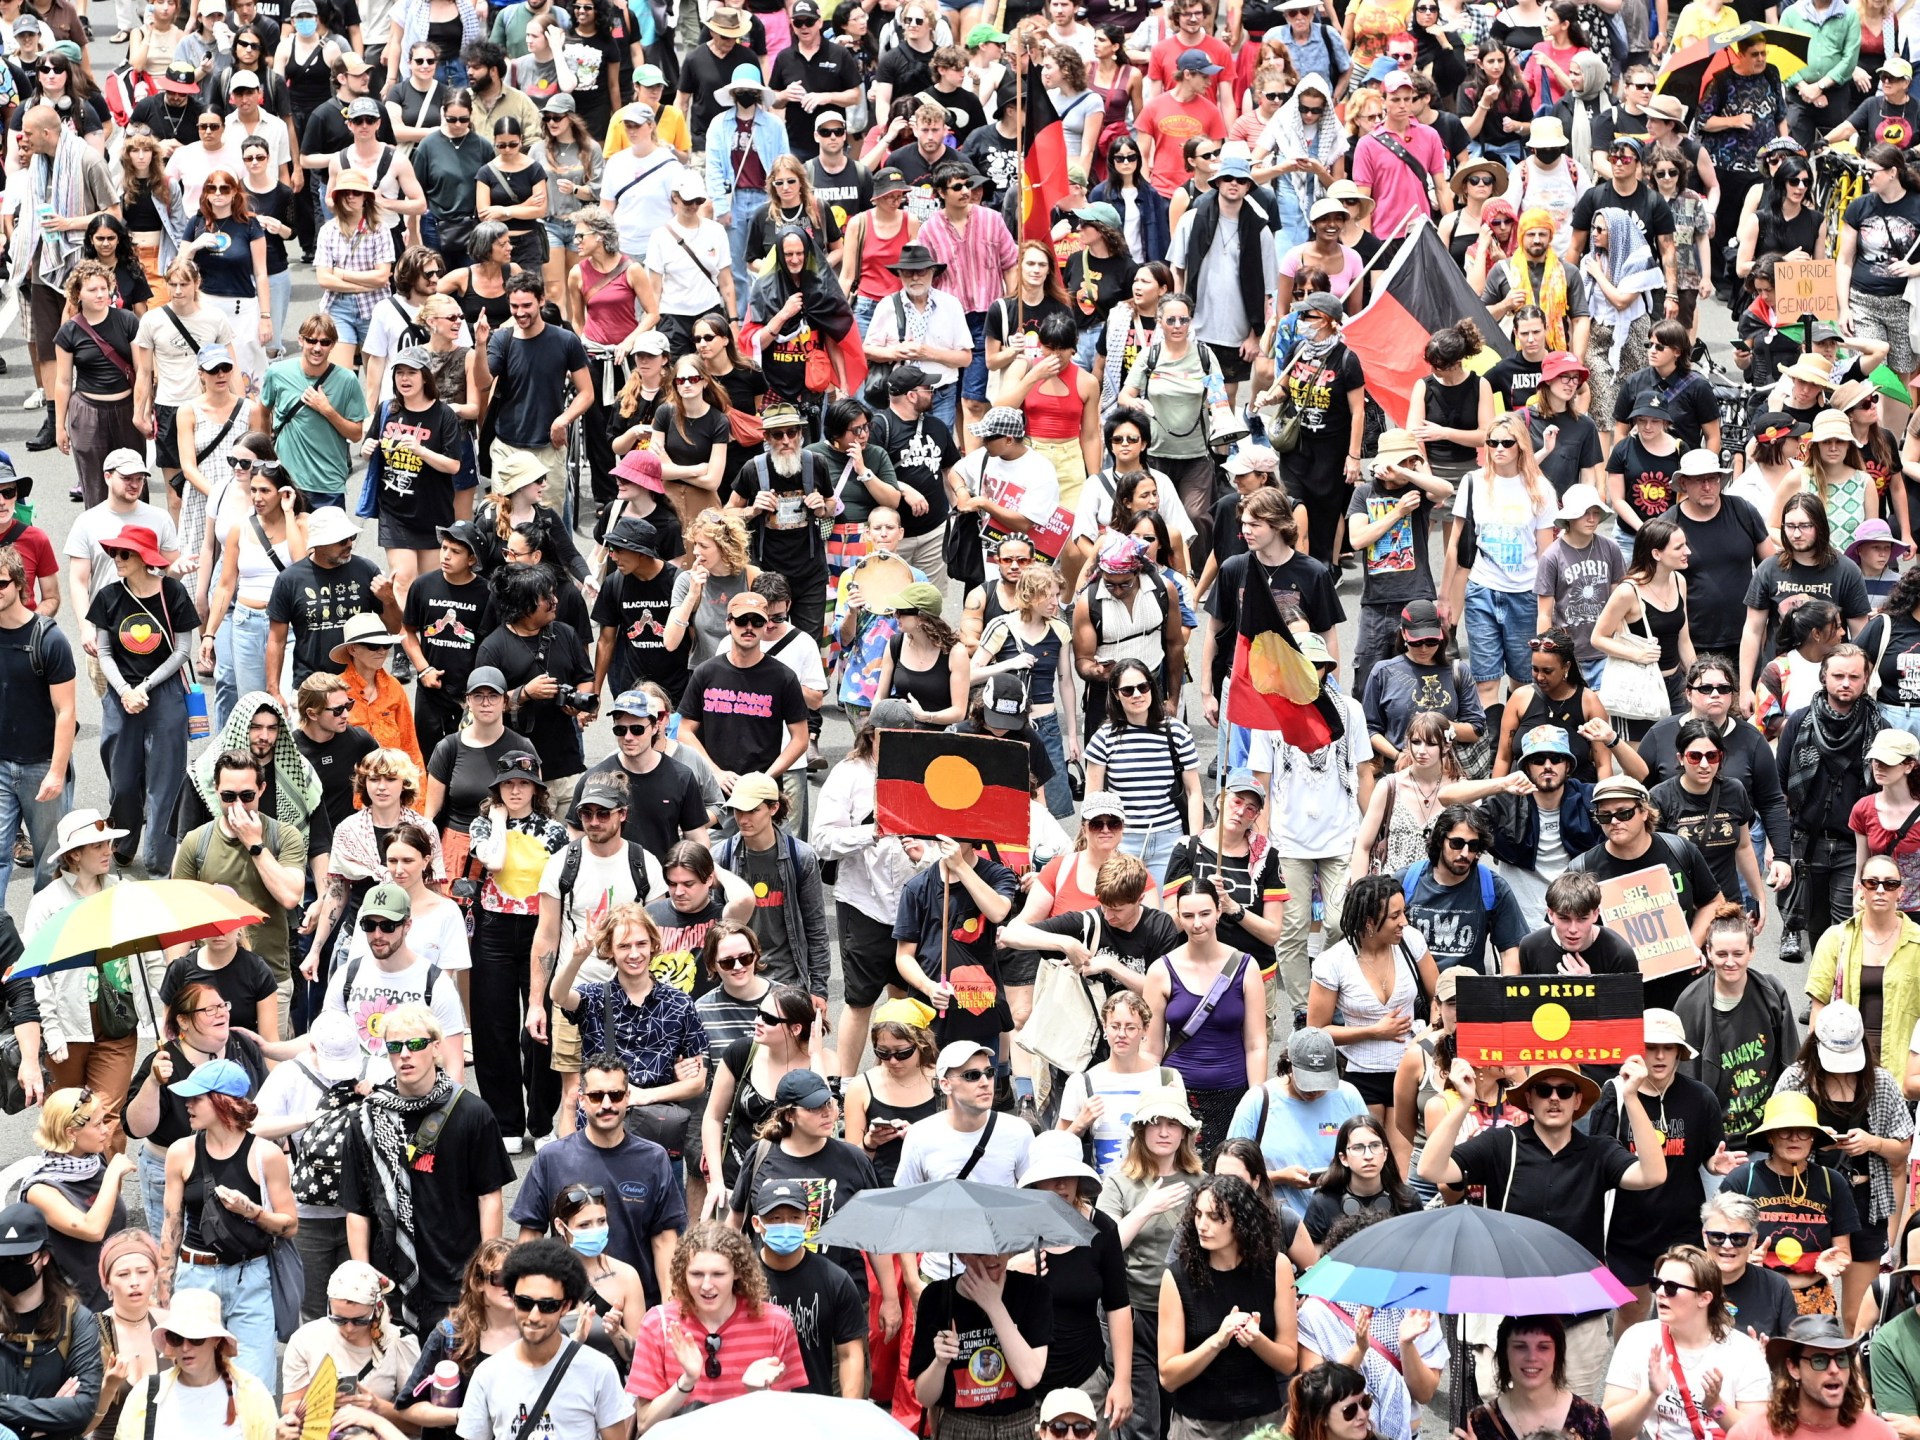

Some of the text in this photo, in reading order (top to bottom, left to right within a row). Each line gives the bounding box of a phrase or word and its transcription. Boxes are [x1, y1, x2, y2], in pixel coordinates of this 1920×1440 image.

[1778, 264, 1832, 280] NO PRIDE
[1797, 280, 1813, 295] IN
[1777, 296, 1835, 314] GENOCIDE
[1639, 484, 1665, 500] Yes
[1050, 517, 1070, 532] WITH
[1564, 560, 1609, 585] SPIRIT
[1776, 581, 1832, 599] MEGADETH
[428, 599, 477, 613] BLACKFULLAS
[622, 600, 669, 614] BLACKFULLAS
[427, 637, 471, 651] PALESTINIANS
[1623, 909, 1669, 948] NOT
[956, 991, 972, 1001] THE
[1506, 984, 1596, 998] NO PRIDE
[957, 1000, 995, 1009] STATEMENT
[1480, 1047, 1622, 1061] IN GENOCIDE
[1721, 1038, 1765, 1069] ALWAYS
[1733, 1068, 1761, 1088] WAS
[963, 1338, 990, 1349] DUNGAY
